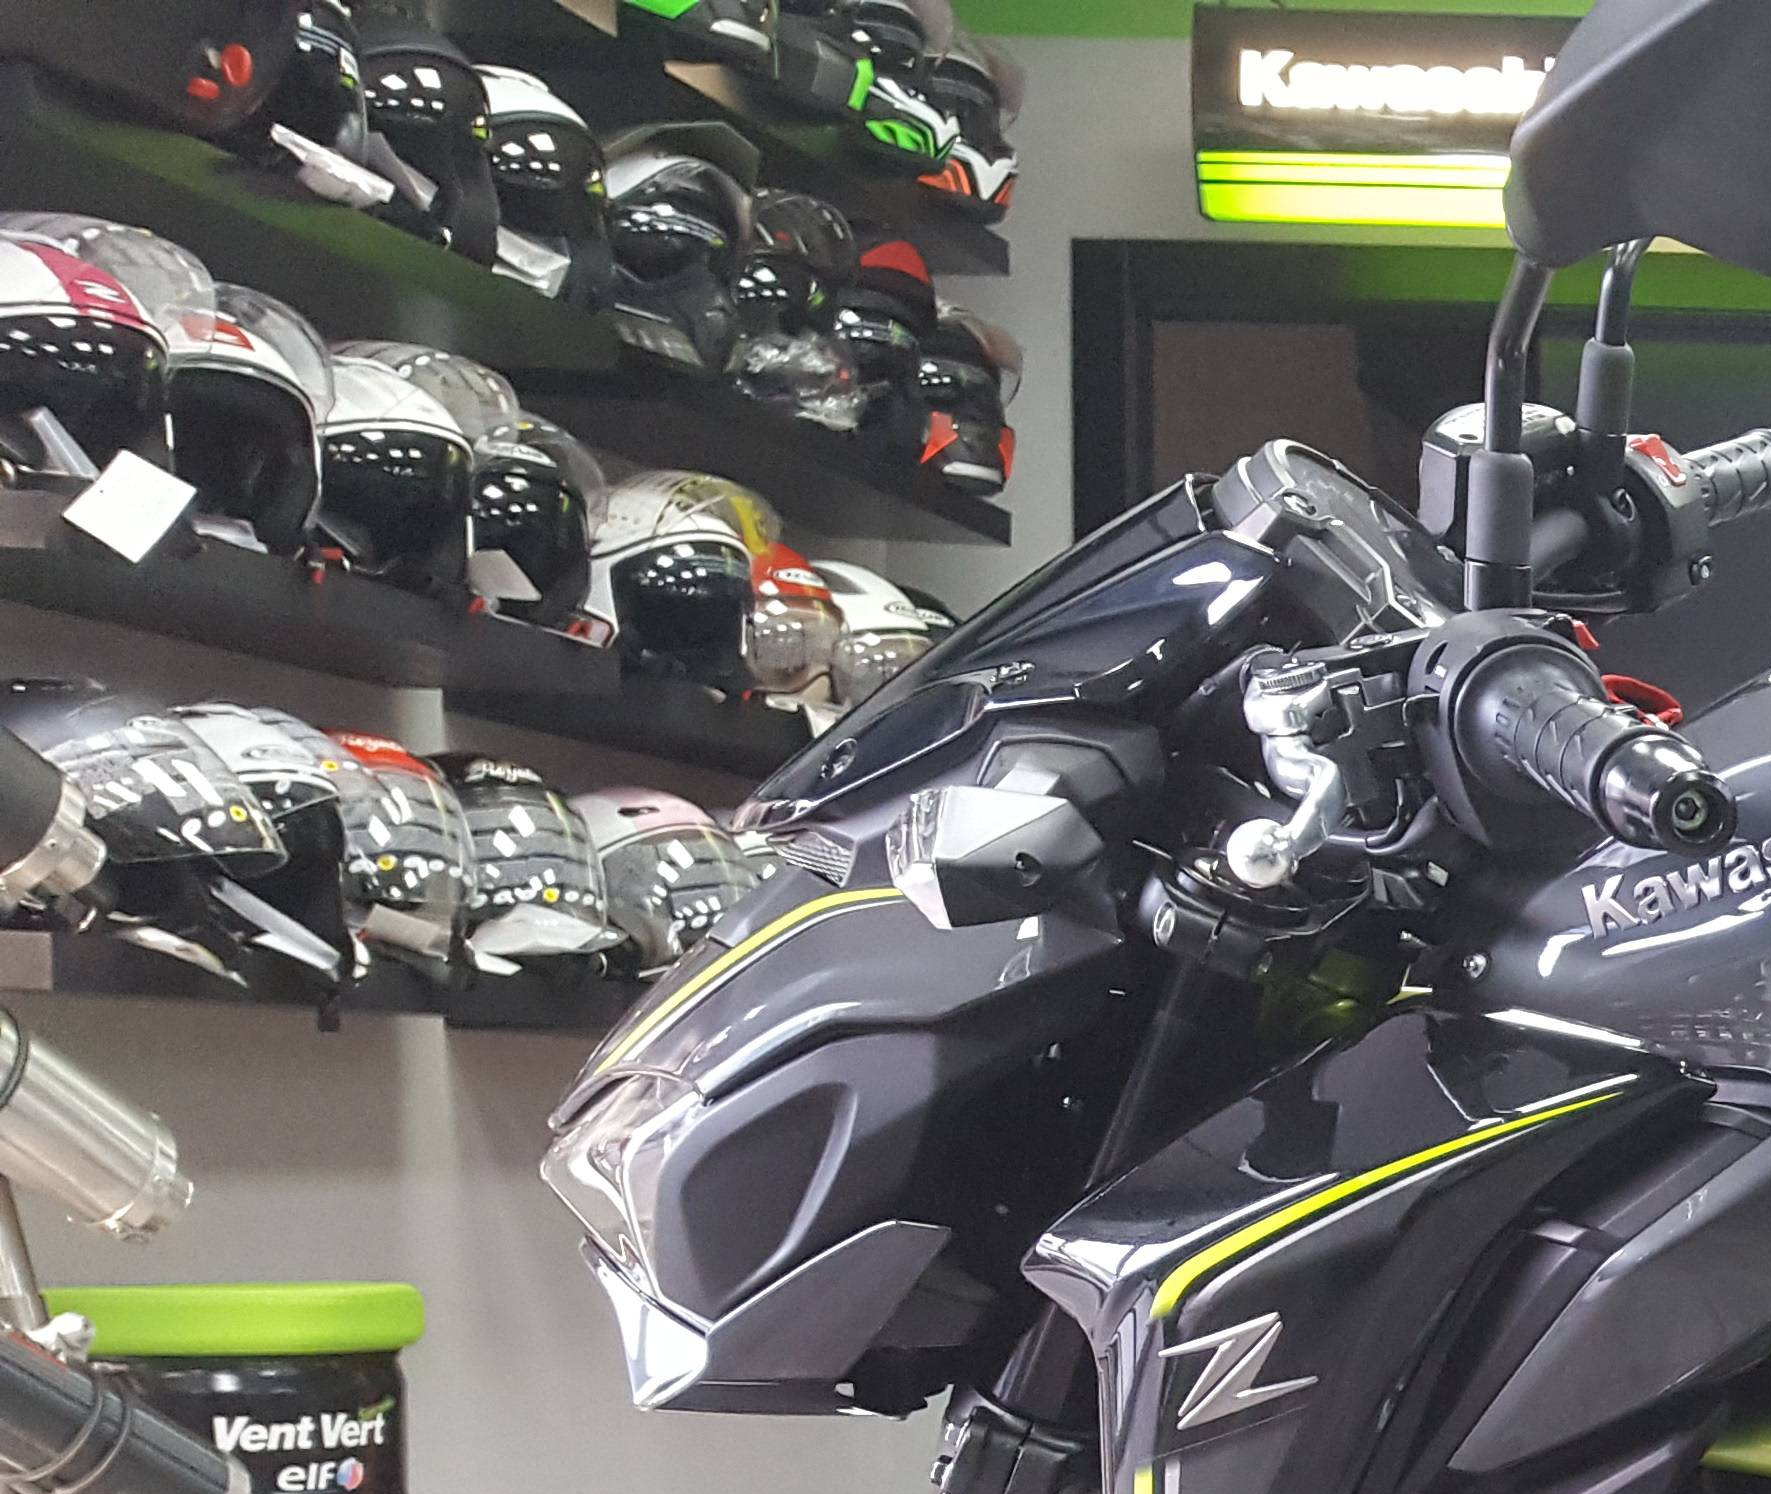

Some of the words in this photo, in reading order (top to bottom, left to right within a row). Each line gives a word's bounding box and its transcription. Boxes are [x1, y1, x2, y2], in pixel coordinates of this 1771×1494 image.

[1239, 48, 1556, 114] Kawasak
[212, 1415, 316, 1453] Vent
[320, 1412, 386, 1449] Vert
[276, 1461, 337, 1492] elf
